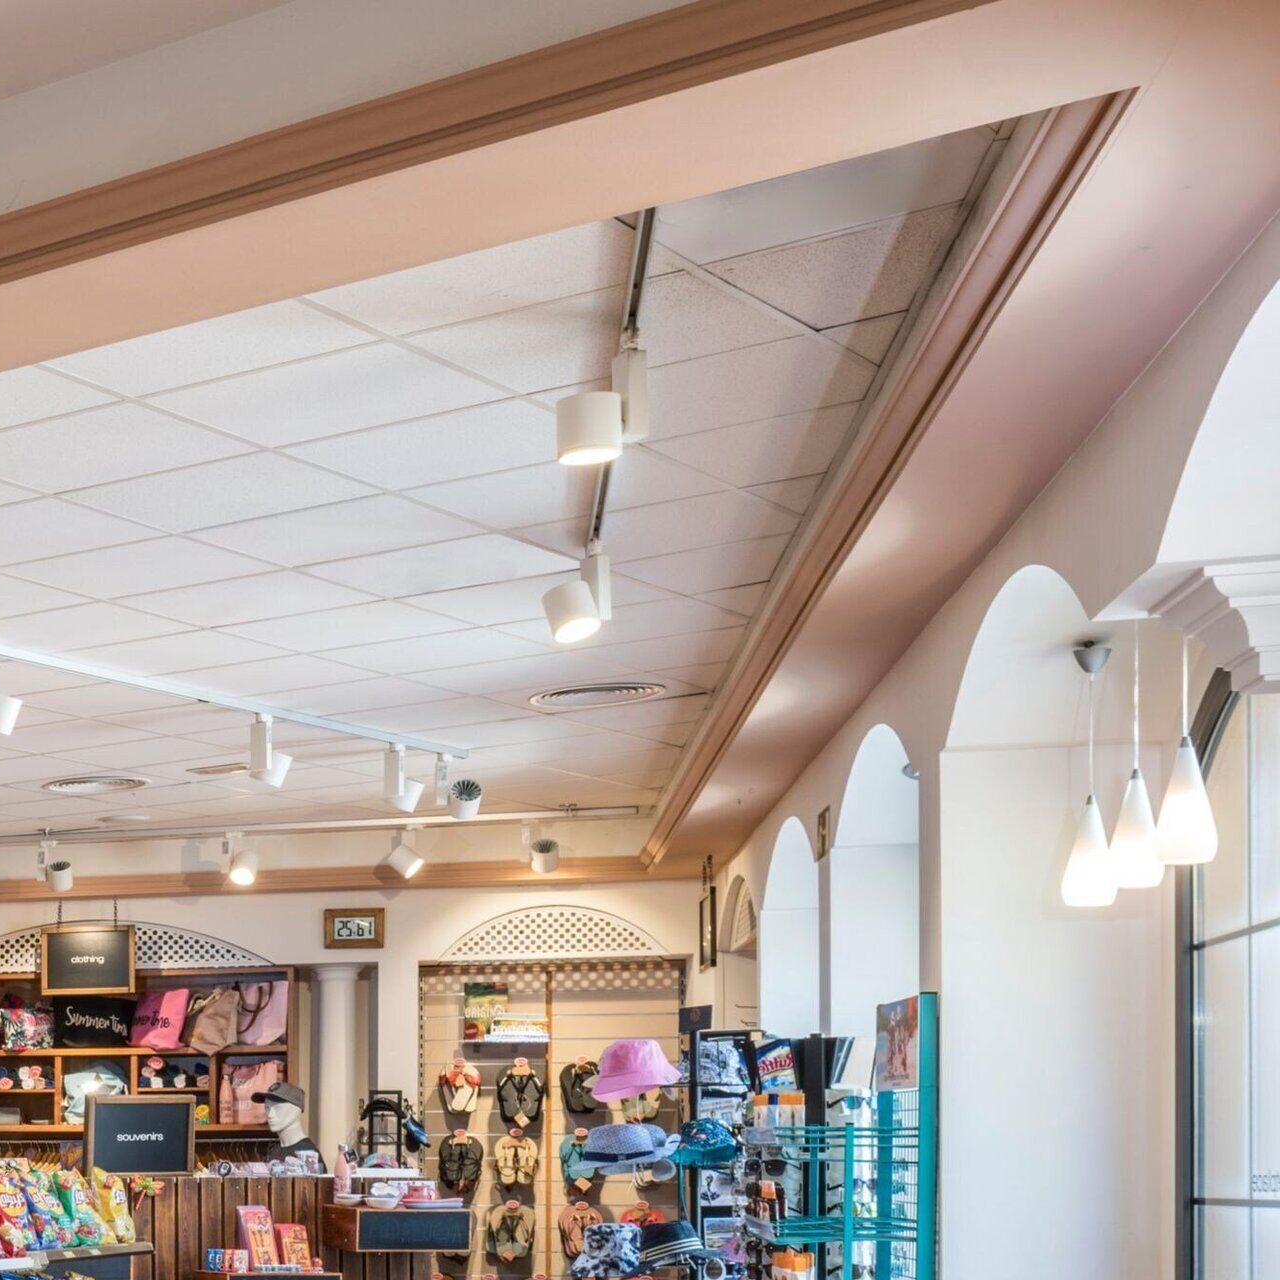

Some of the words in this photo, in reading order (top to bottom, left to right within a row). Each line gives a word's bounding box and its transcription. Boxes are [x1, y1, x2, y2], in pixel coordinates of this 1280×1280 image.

[70, 955, 105, 965] clothing
[65, 1006, 111, 1030] Summer
[116, 1131, 164, 1142] souvenirs
